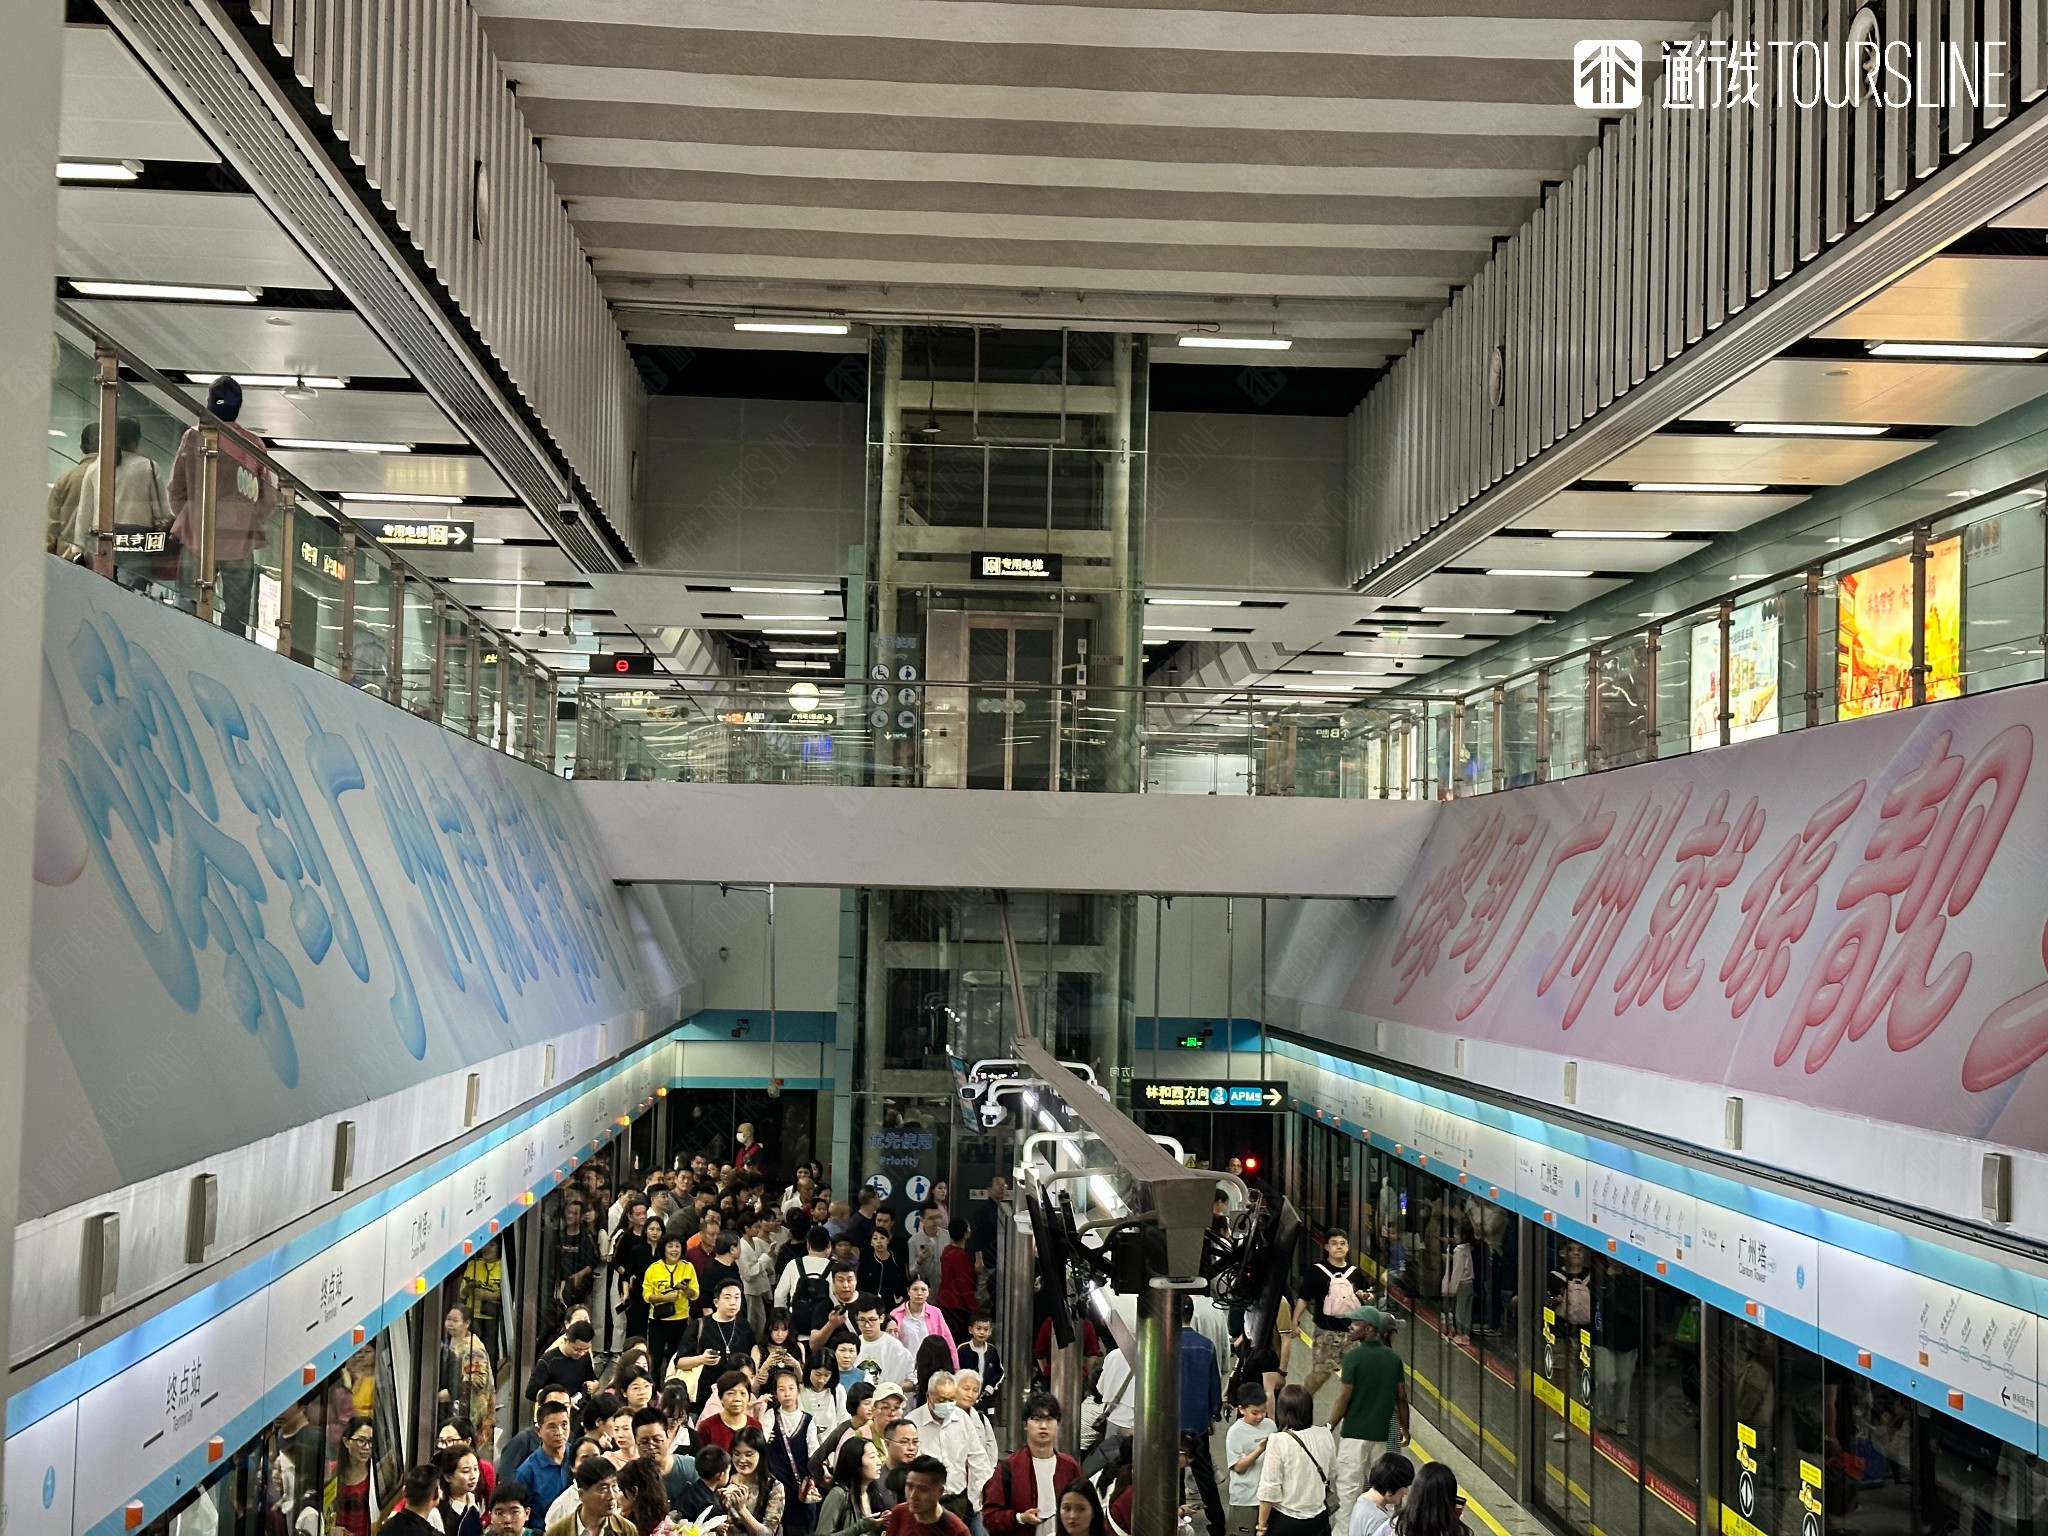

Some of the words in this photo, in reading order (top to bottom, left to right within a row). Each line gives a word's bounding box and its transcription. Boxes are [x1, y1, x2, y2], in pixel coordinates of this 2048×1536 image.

[382, 524, 429, 538] 专用电梯
[1001, 558, 1044, 571] 专用电梯
[1145, 1085, 1210, 1099] 林和西方向
[869, 1132, 933, 1150] 优先使用
[879, 1156, 920, 1168] Priority
[1540, 1160, 1558, 1186] 广州塔
[411, 1210, 428, 1246] 广州塔
[1738, 1233, 1767, 1270] 广州塔
[1738, 1262, 1754, 1279] Canton
[1753, 1268, 1767, 1284] Tower
[320, 1265, 344, 1309] 终点站
[165, 1355, 202, 1415] 终点站
[172, 1402, 194, 1434] Terminal
